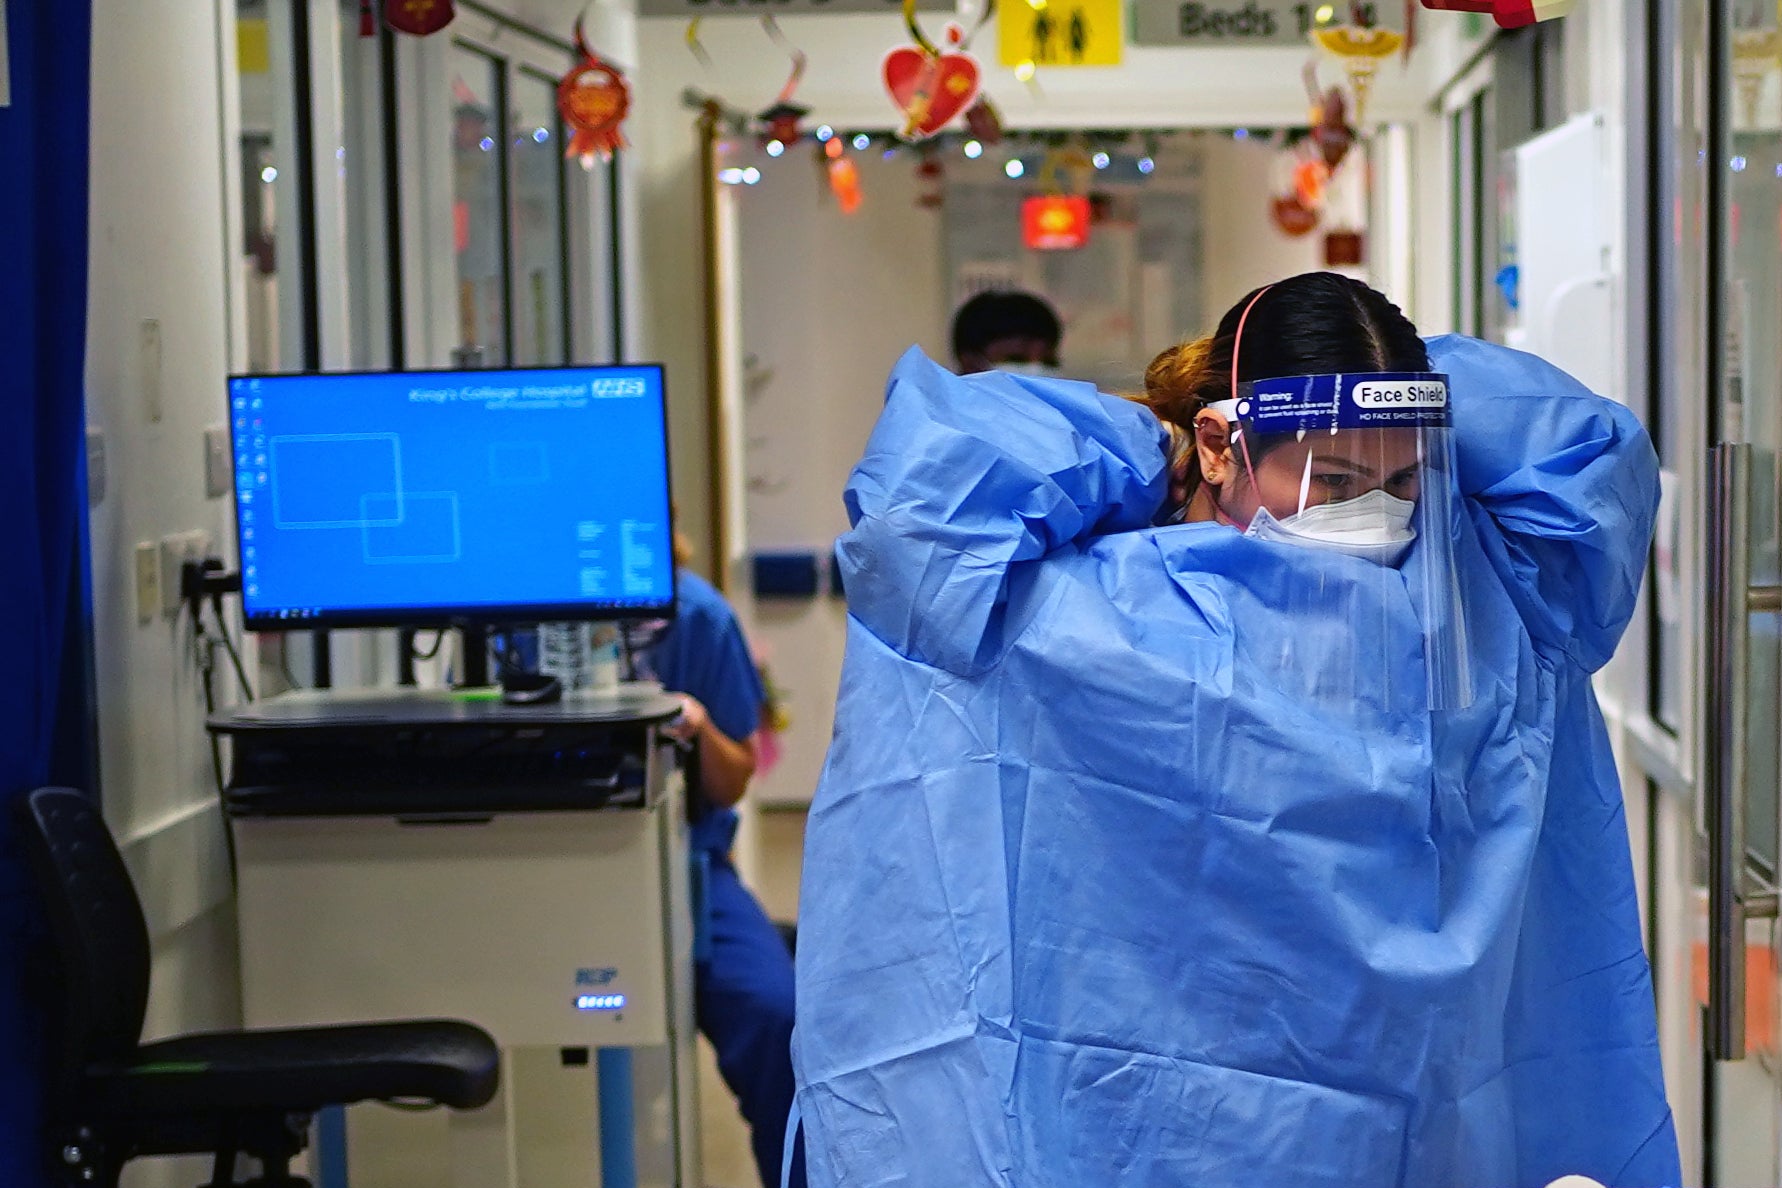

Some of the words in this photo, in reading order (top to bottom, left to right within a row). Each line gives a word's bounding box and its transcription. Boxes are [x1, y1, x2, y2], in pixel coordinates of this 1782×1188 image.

[1179, 1, 1276, 37] Beds
[1361, 387, 1402, 403] Face
[1407, 385, 1444, 402] Shield
[1372, 412, 1391, 420] FACE
